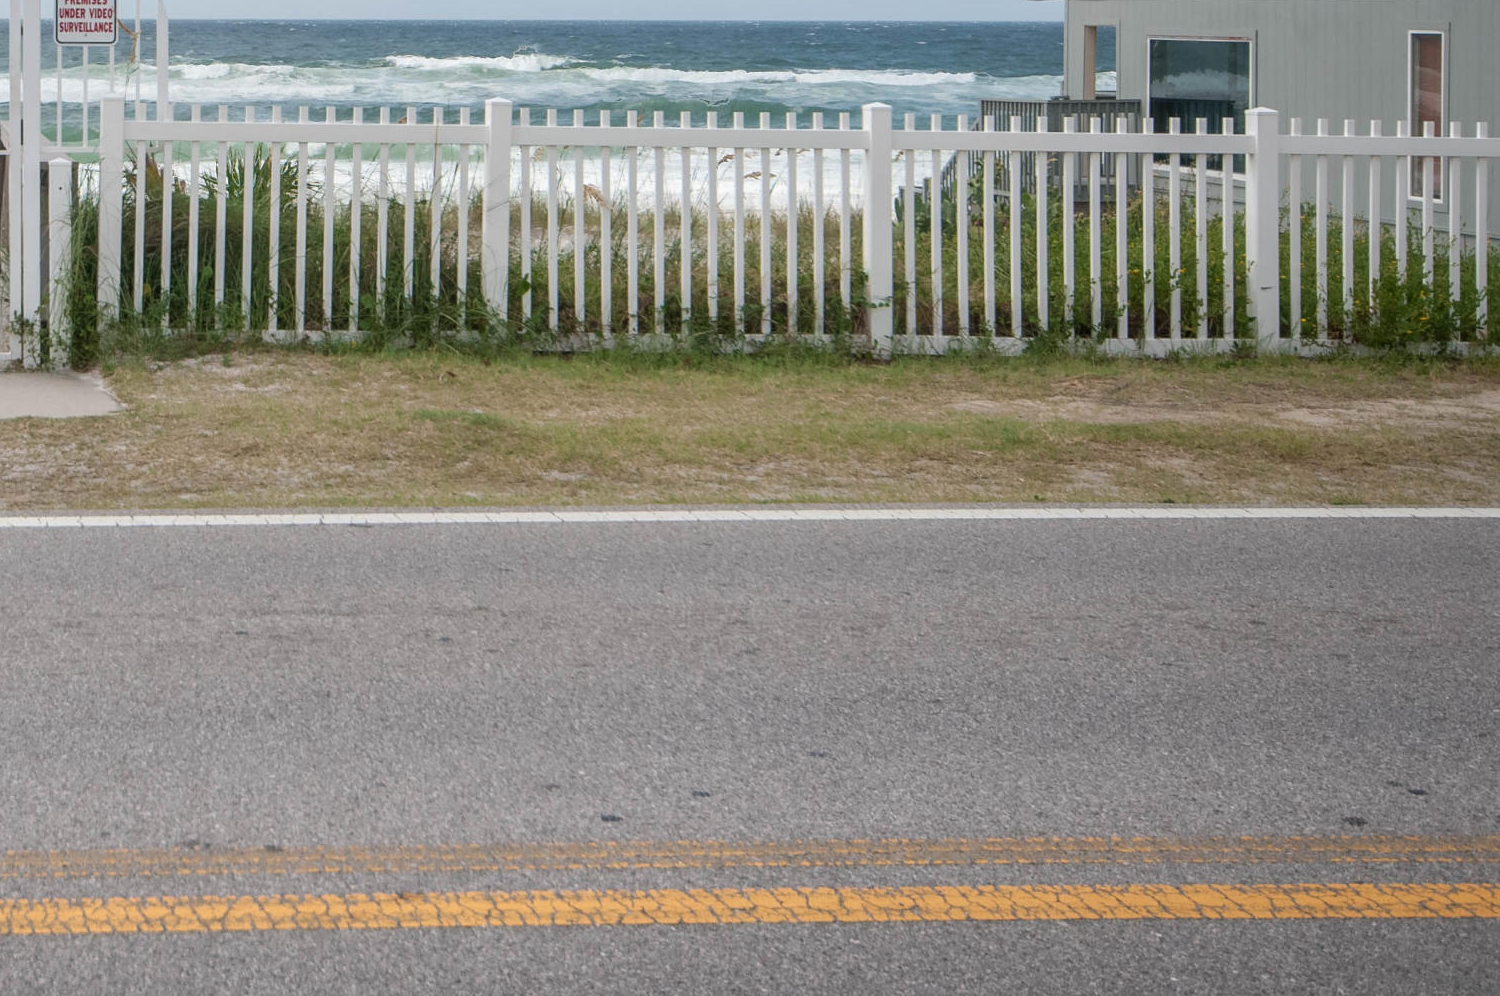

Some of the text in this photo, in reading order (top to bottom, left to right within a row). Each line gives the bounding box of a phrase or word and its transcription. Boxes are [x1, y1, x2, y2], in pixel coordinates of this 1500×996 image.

[59, 8, 113, 19] UNDER VIDEO
[59, 22, 113, 33] SURVEILLANCE
